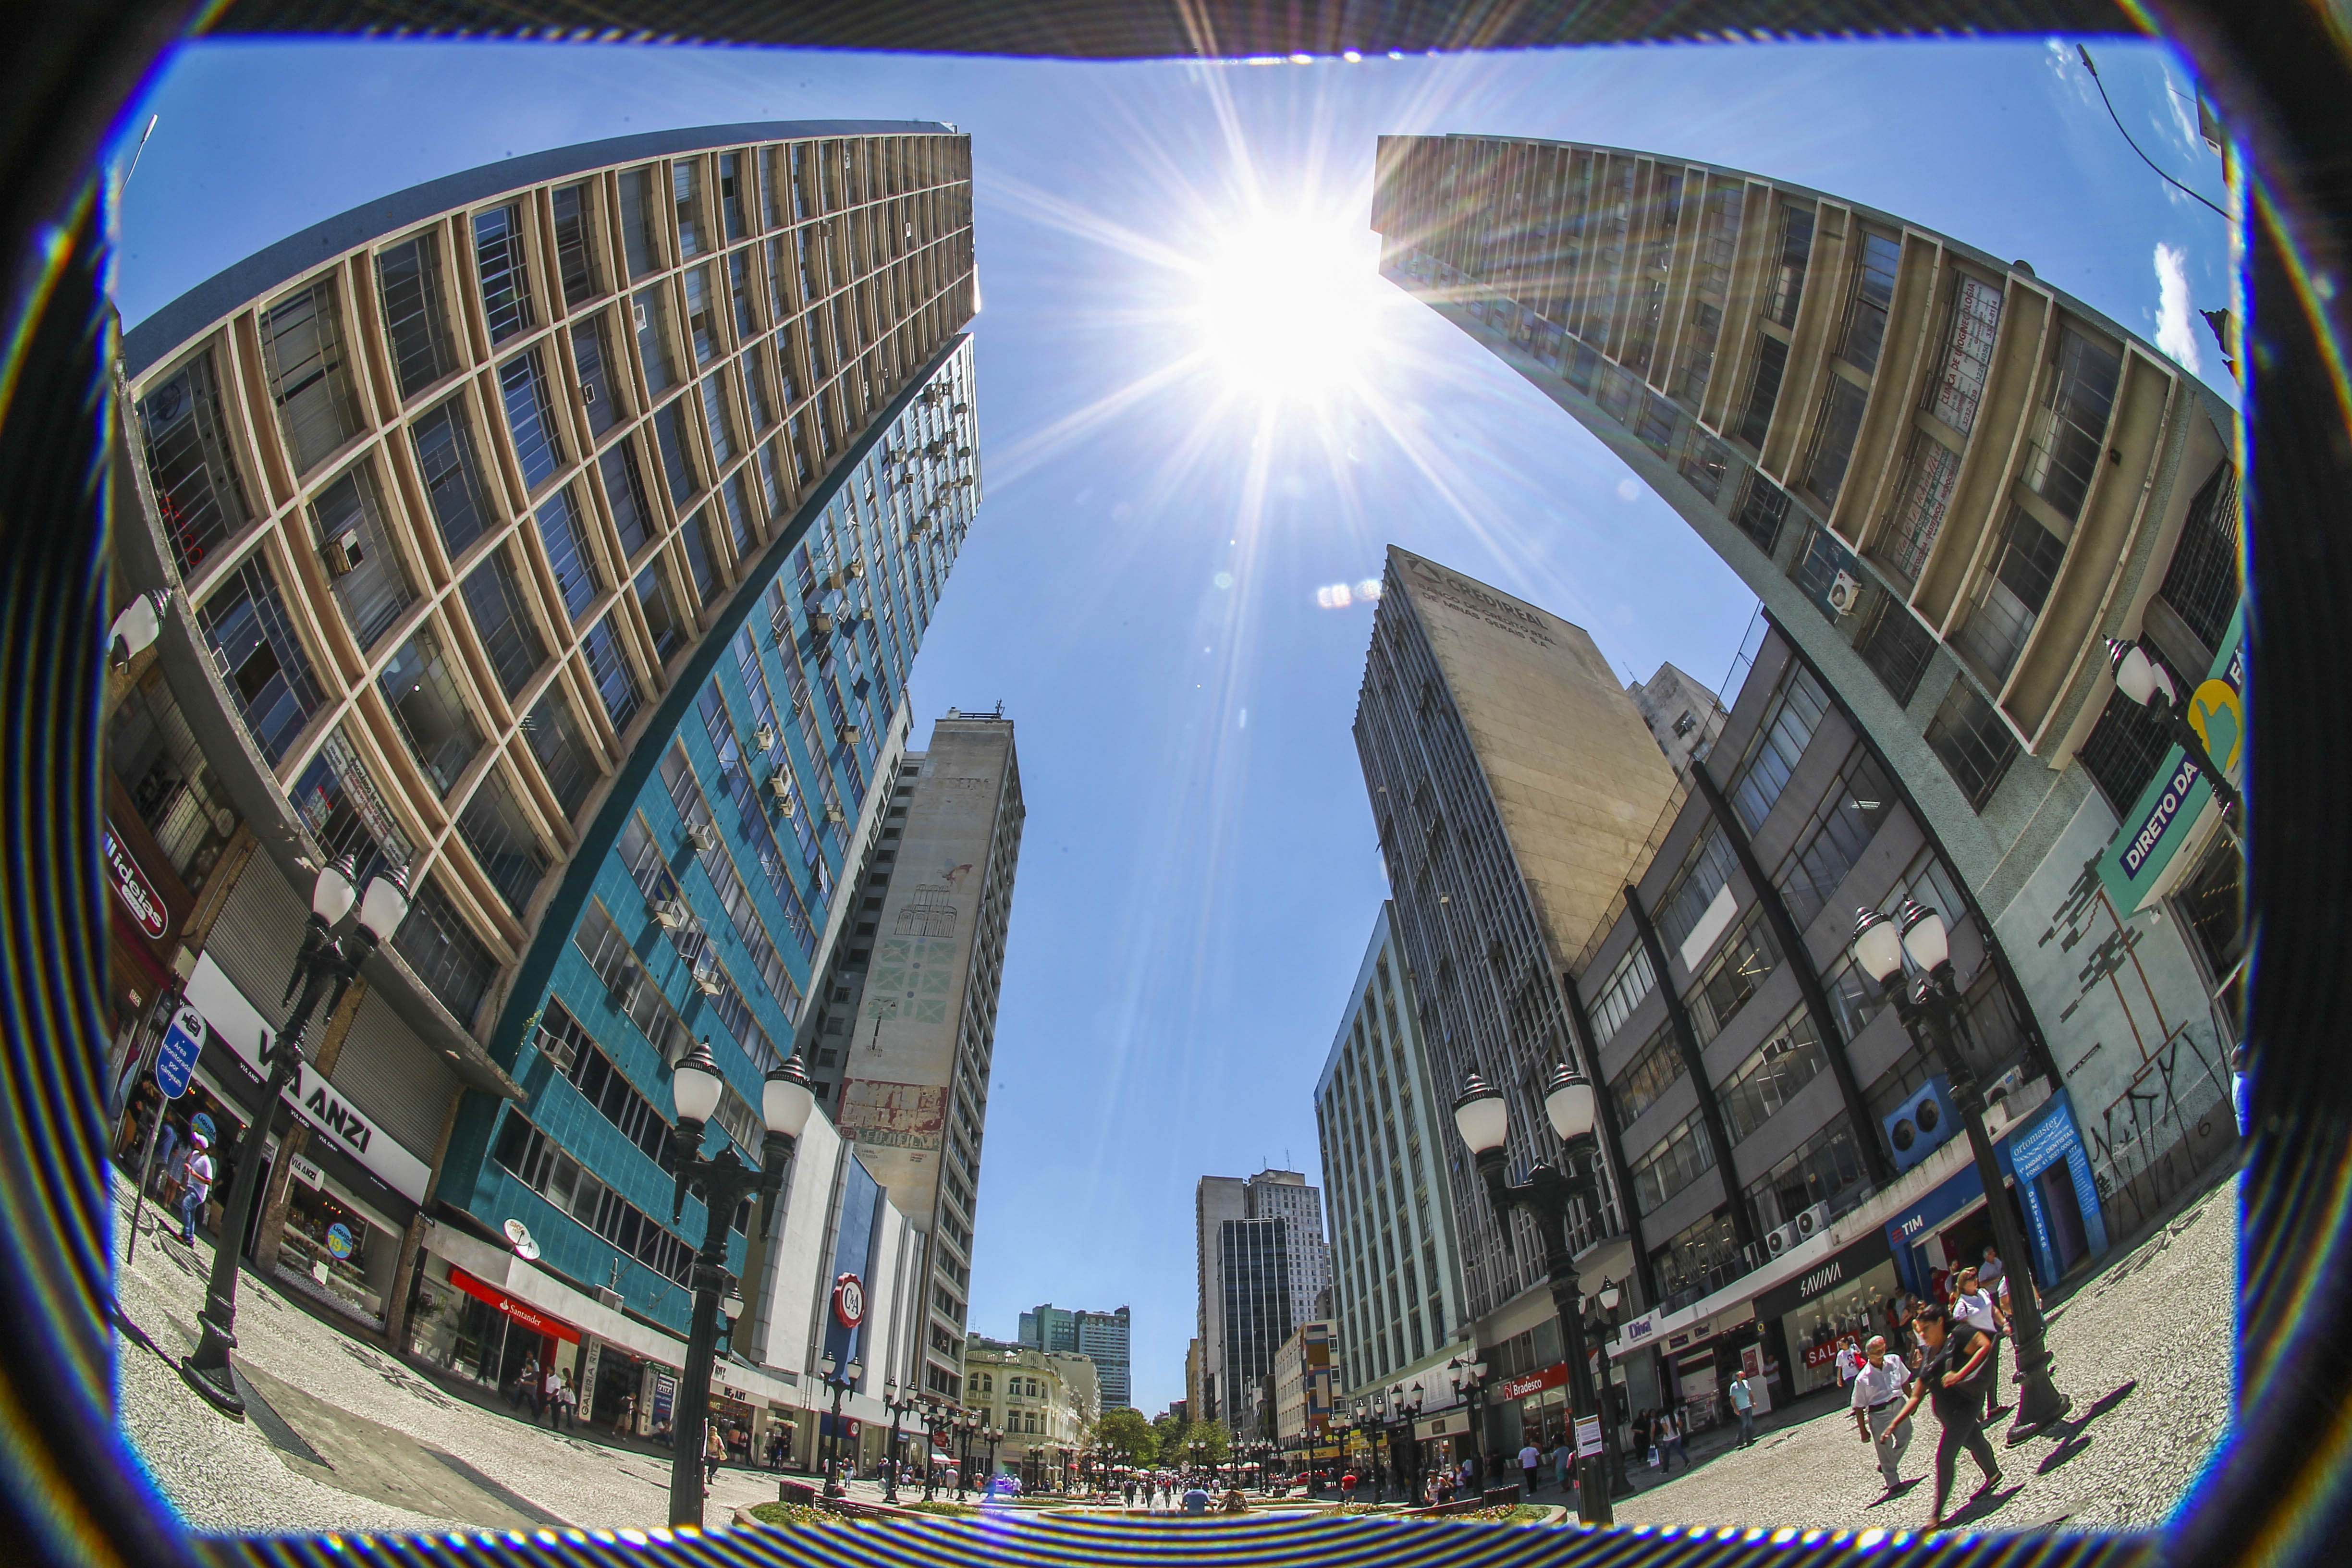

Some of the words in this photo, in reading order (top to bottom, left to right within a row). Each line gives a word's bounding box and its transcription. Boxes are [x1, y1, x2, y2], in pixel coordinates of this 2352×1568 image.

[1986, 300, 1997, 339] 334-814
[1941, 372, 1957, 405] CLINCA
[1951, 358, 1960, 371] DE
[1961, 389, 1978, 427] 3232-339
[1418, 582, 1460, 604] BANCO
[1531, 629, 1557, 646] REAL
[1422, 592, 1438, 603] DE
[1443, 600, 1481, 620] MINAS
[1484, 618, 1526, 639] GERAIS
[1446, 577, 1549, 630] CREDIREAL
[2126, 793, 2177, 870] DIRETO
[2173, 761, 2198, 796] DA
[113, 853, 163, 928] ideias
[163, 1043, 191, 1073] monitorada
[174, 1041, 187, 1057] Área
[169, 1061, 179, 1072] por
[240, 1062, 248, 1074] VIA
[258, 1029, 302, 1099] VA
[305, 1087, 372, 1154] ANZI
[291, 1109, 299, 1120] VIA
[318, 1134, 327, 1145] VIA
[2013, 1115, 2058, 1157] ortomaster
[2025, 1154, 2044, 1170] ANDAR
[2046, 1129, 2074, 1154] DENTISTAS
[2069, 1145, 2078, 1154] 177
[291, 1157, 302, 1172] VIA
[301, 1165, 317, 1181] ANZI
[1902, 1214, 1923, 1236] TIM
[2028, 1190, 2047, 1248] DENTISTAS
[1800, 1262, 1842, 1297] SAVINA
[509, 1304, 542, 1326] Santander
[845, 1287, 859, 1315] C&A
[1628, 1320, 1652, 1340] Diva
[582, 1368, 594, 1415] GALERIA
[589, 1341, 600, 1364] RITZ
[658, 1385, 672, 1395] CAIXA
[1513, 1379, 1542, 1396] Bradesco
[735, 1390, 746, 1401] ART
